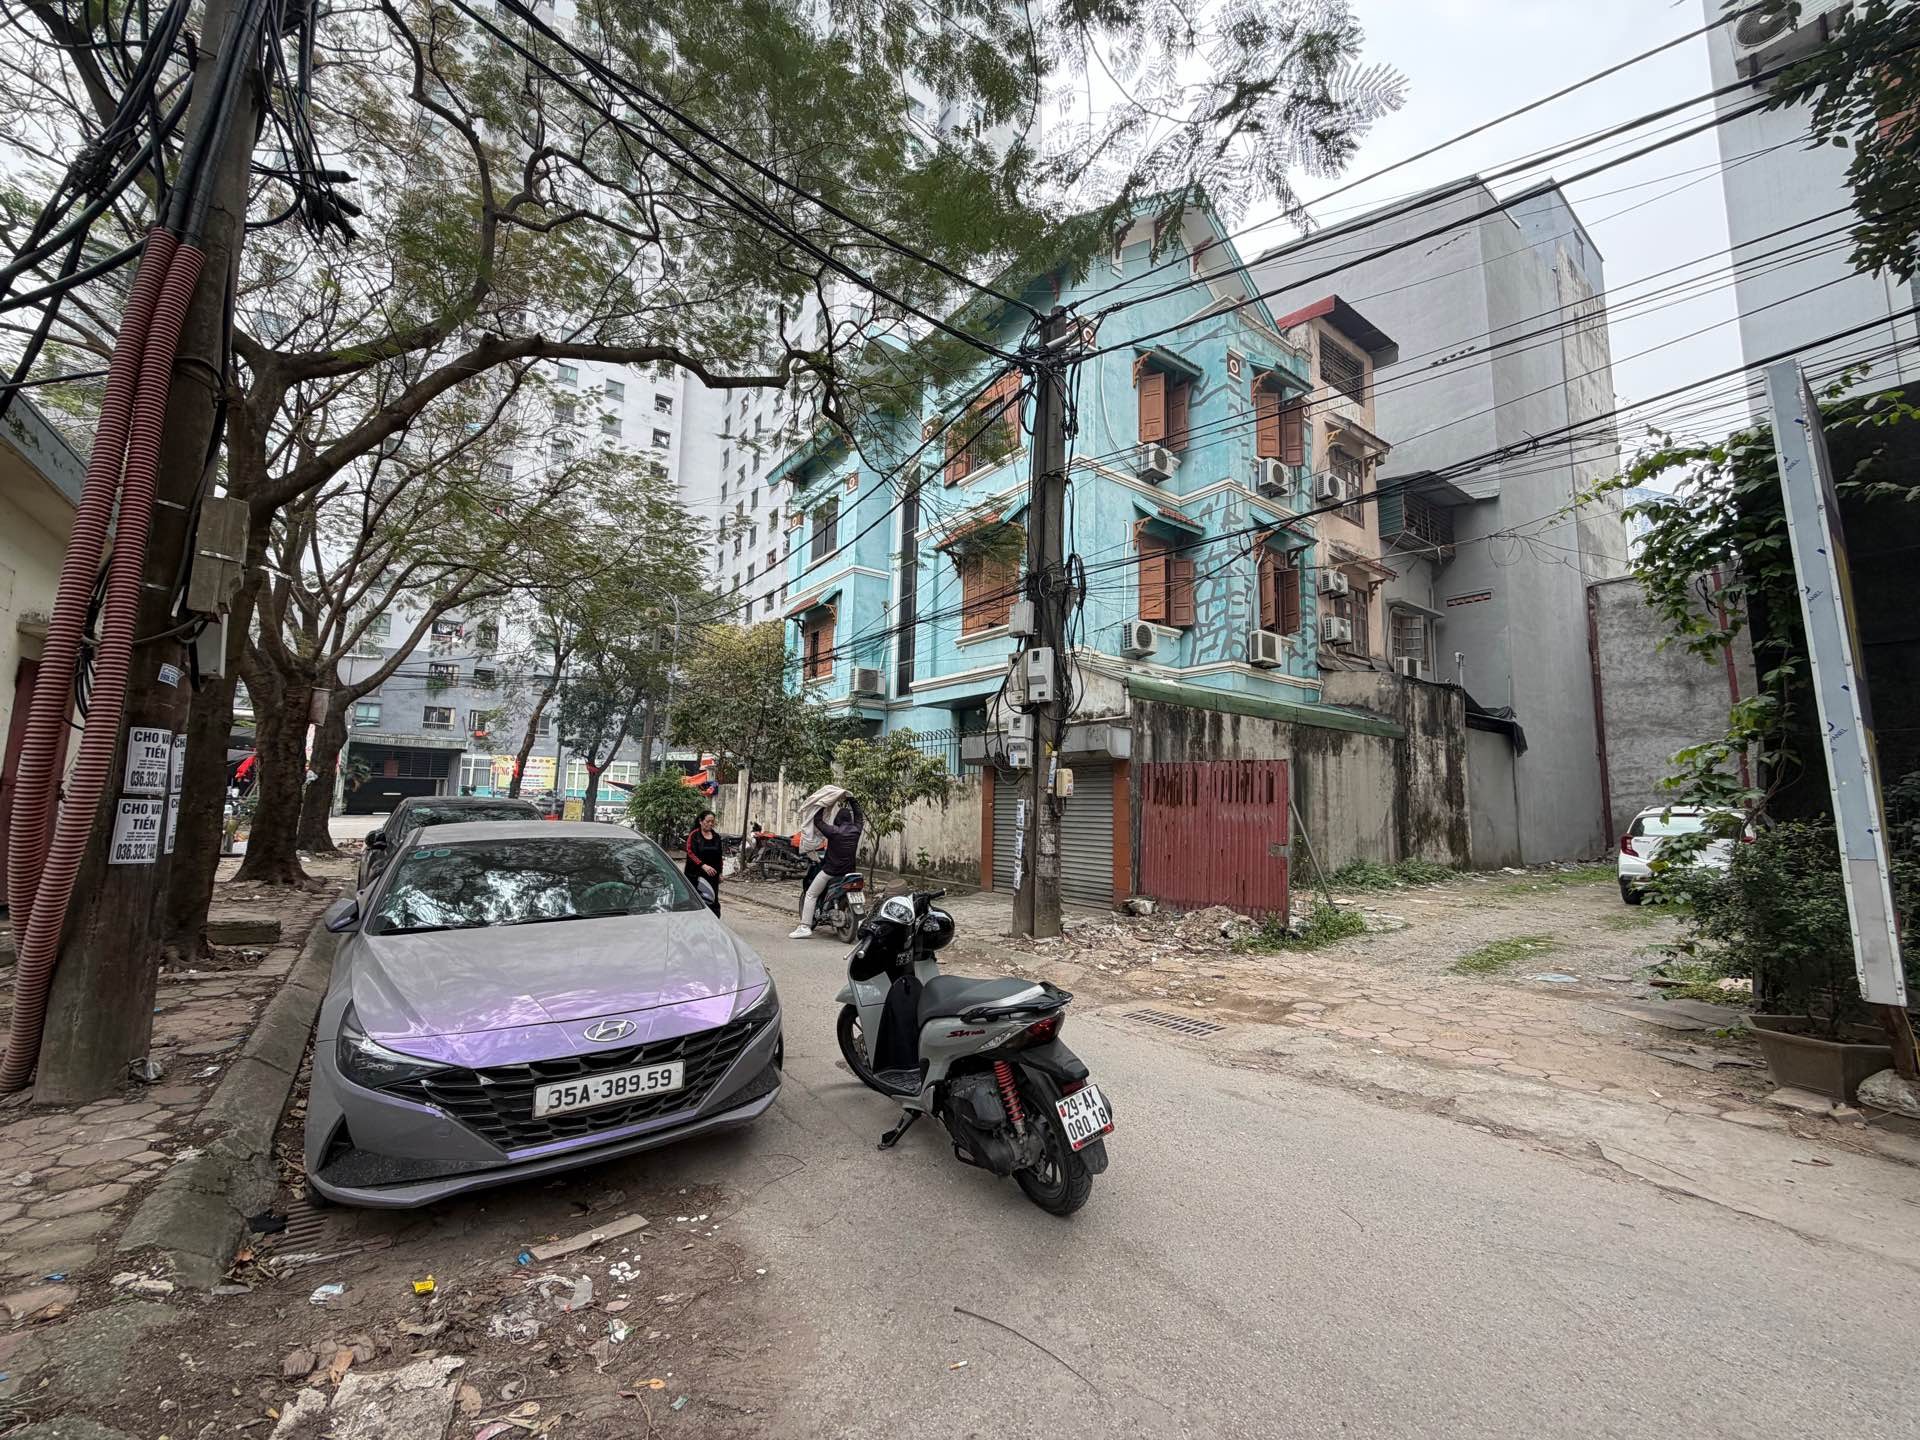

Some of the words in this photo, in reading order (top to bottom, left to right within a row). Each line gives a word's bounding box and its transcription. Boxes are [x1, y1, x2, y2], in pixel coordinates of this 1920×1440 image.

[134, 731, 159, 743] CHO
[122, 802, 148, 814] CHO
[549, 1069, 672, 1109] 35A-389.59
[1064, 1089, 1097, 1120] 29-AX
[1068, 1107, 1108, 1141] 080.18
